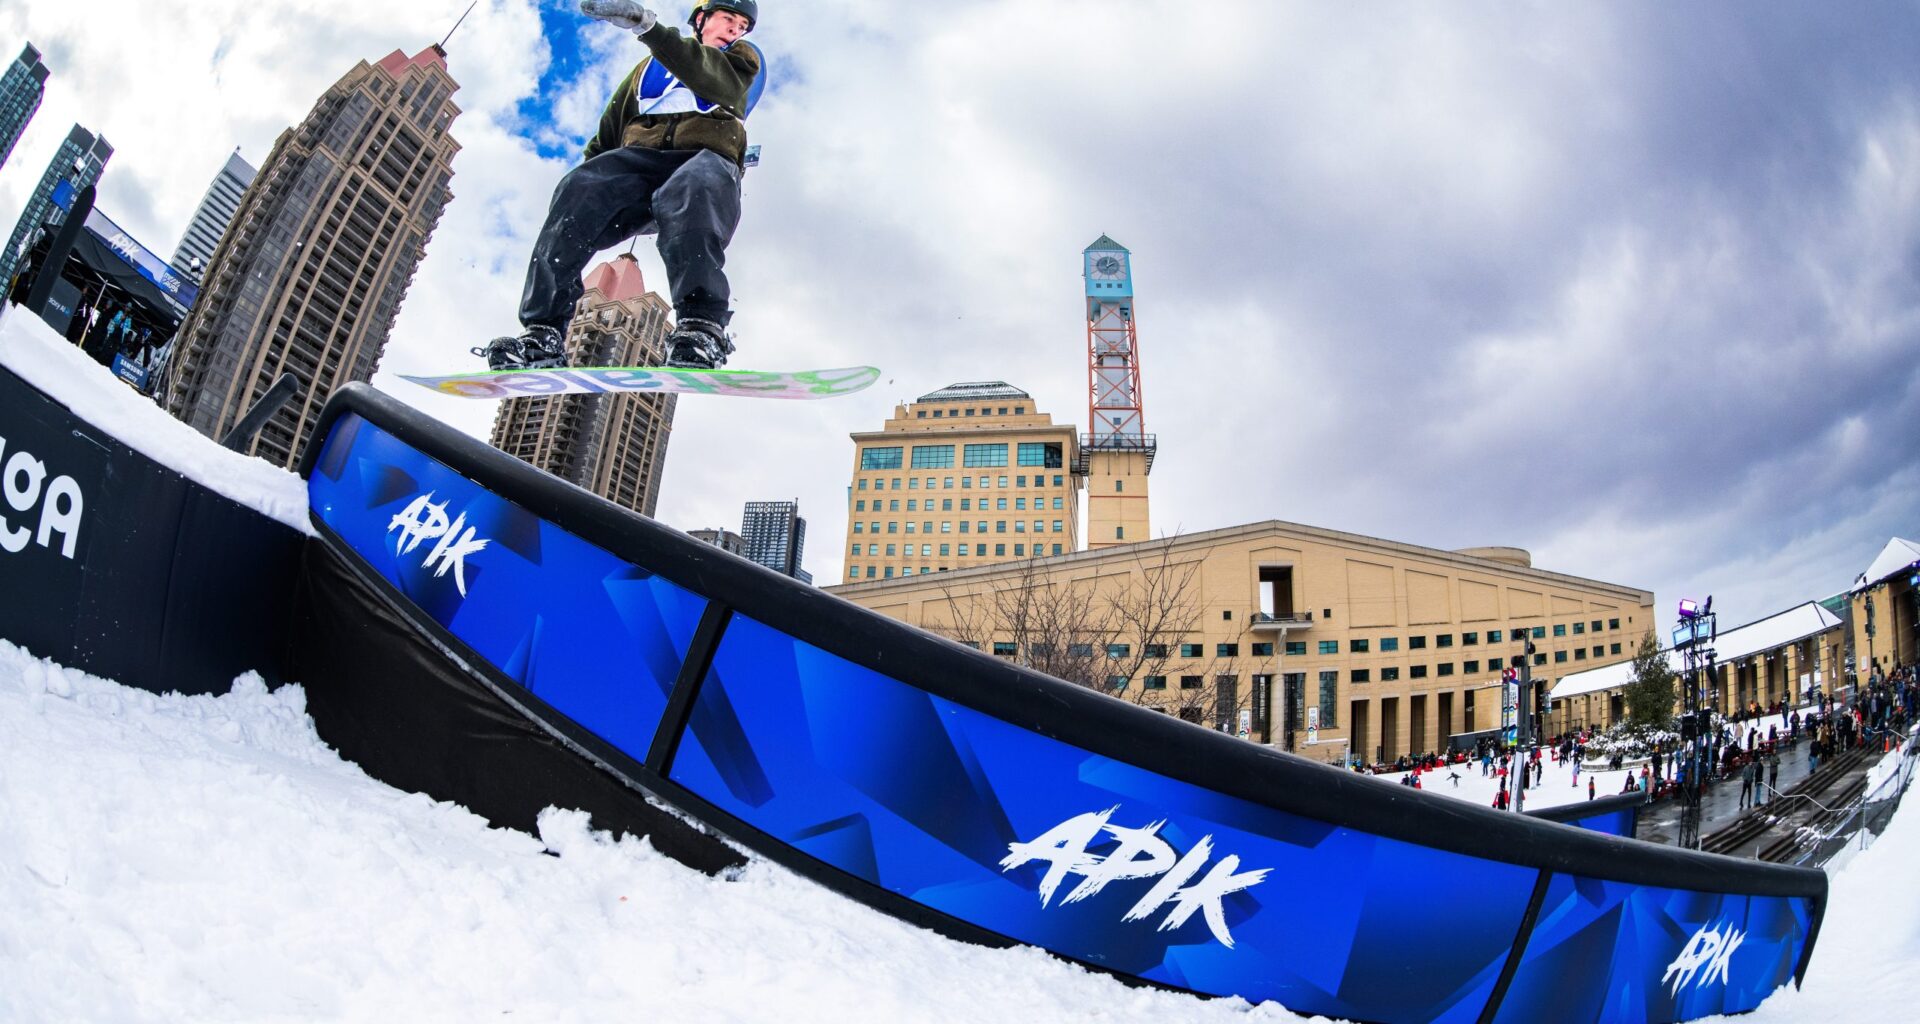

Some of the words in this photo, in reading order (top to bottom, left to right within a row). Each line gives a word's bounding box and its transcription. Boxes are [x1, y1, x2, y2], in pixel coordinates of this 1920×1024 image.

[107, 233, 140, 263] APIK
[119, 358, 144, 377] SAMSUNG
[120, 368, 138, 383] Galaxy
[387, 489, 492, 599] APIK
[999, 803, 1275, 949] APIK
[1661, 917, 1748, 1000] APIK
